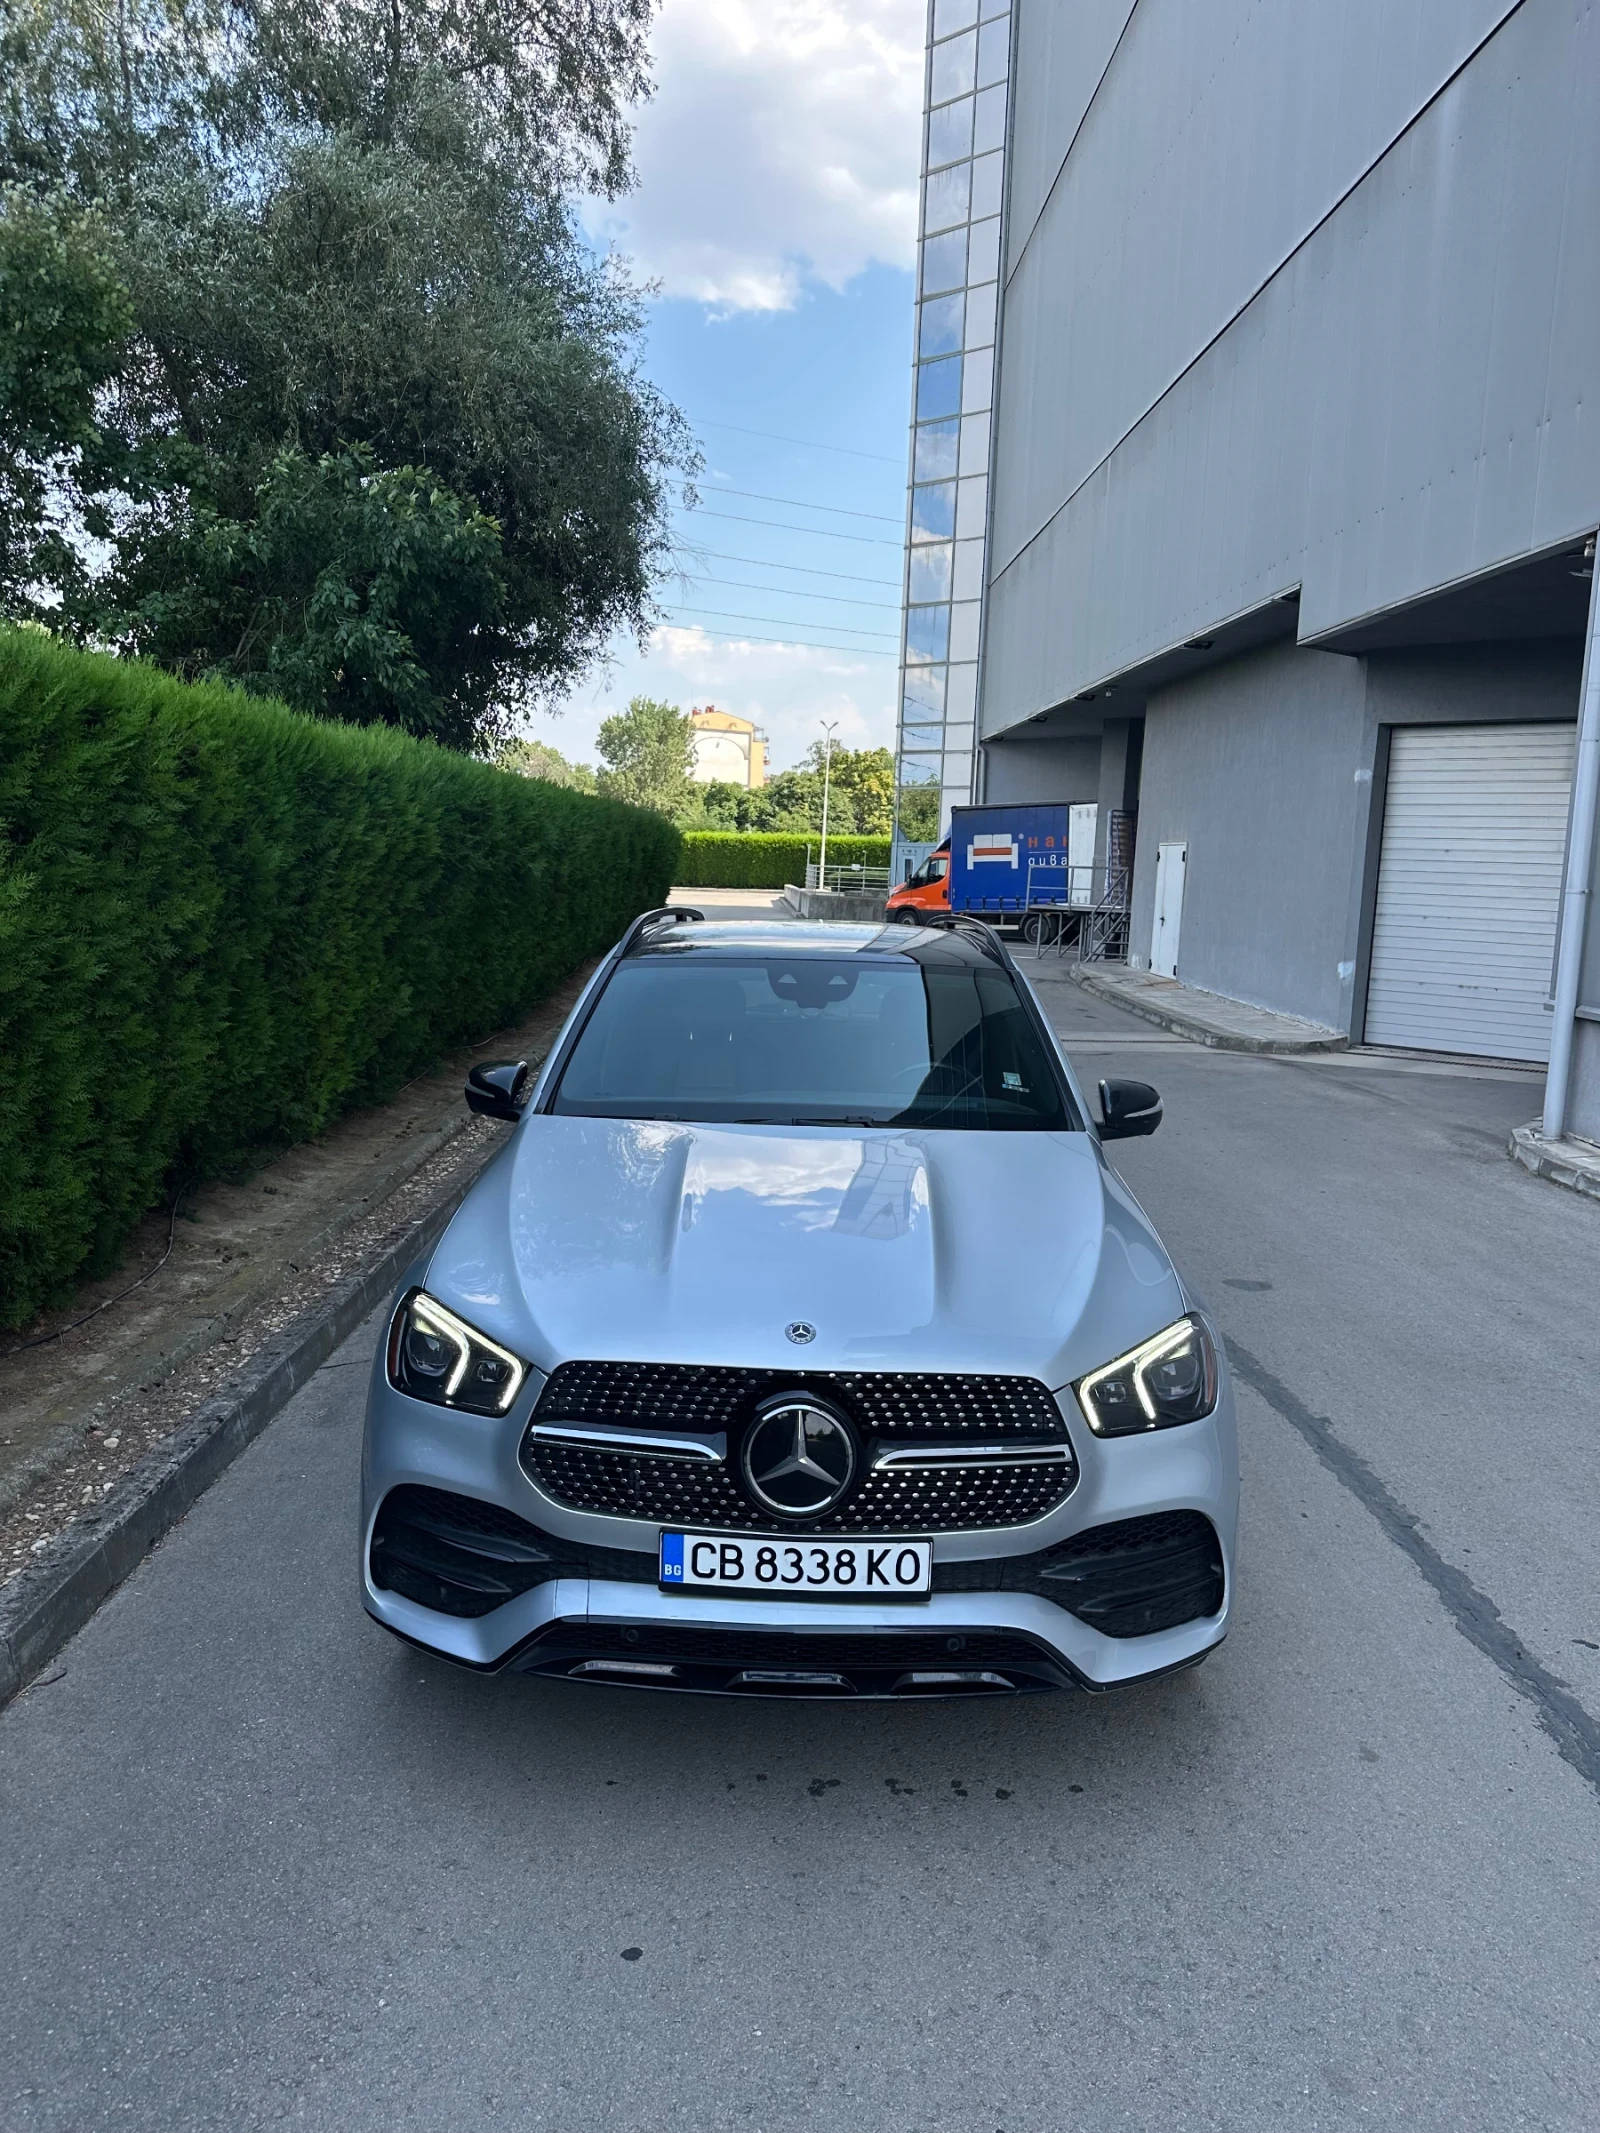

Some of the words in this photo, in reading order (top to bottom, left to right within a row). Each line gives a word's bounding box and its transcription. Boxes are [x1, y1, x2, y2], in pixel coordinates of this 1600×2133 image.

[664, 1563, 682, 1577] BG
[691, 1541, 745, 1580] CB
[754, 1546, 857, 1586] 8338
